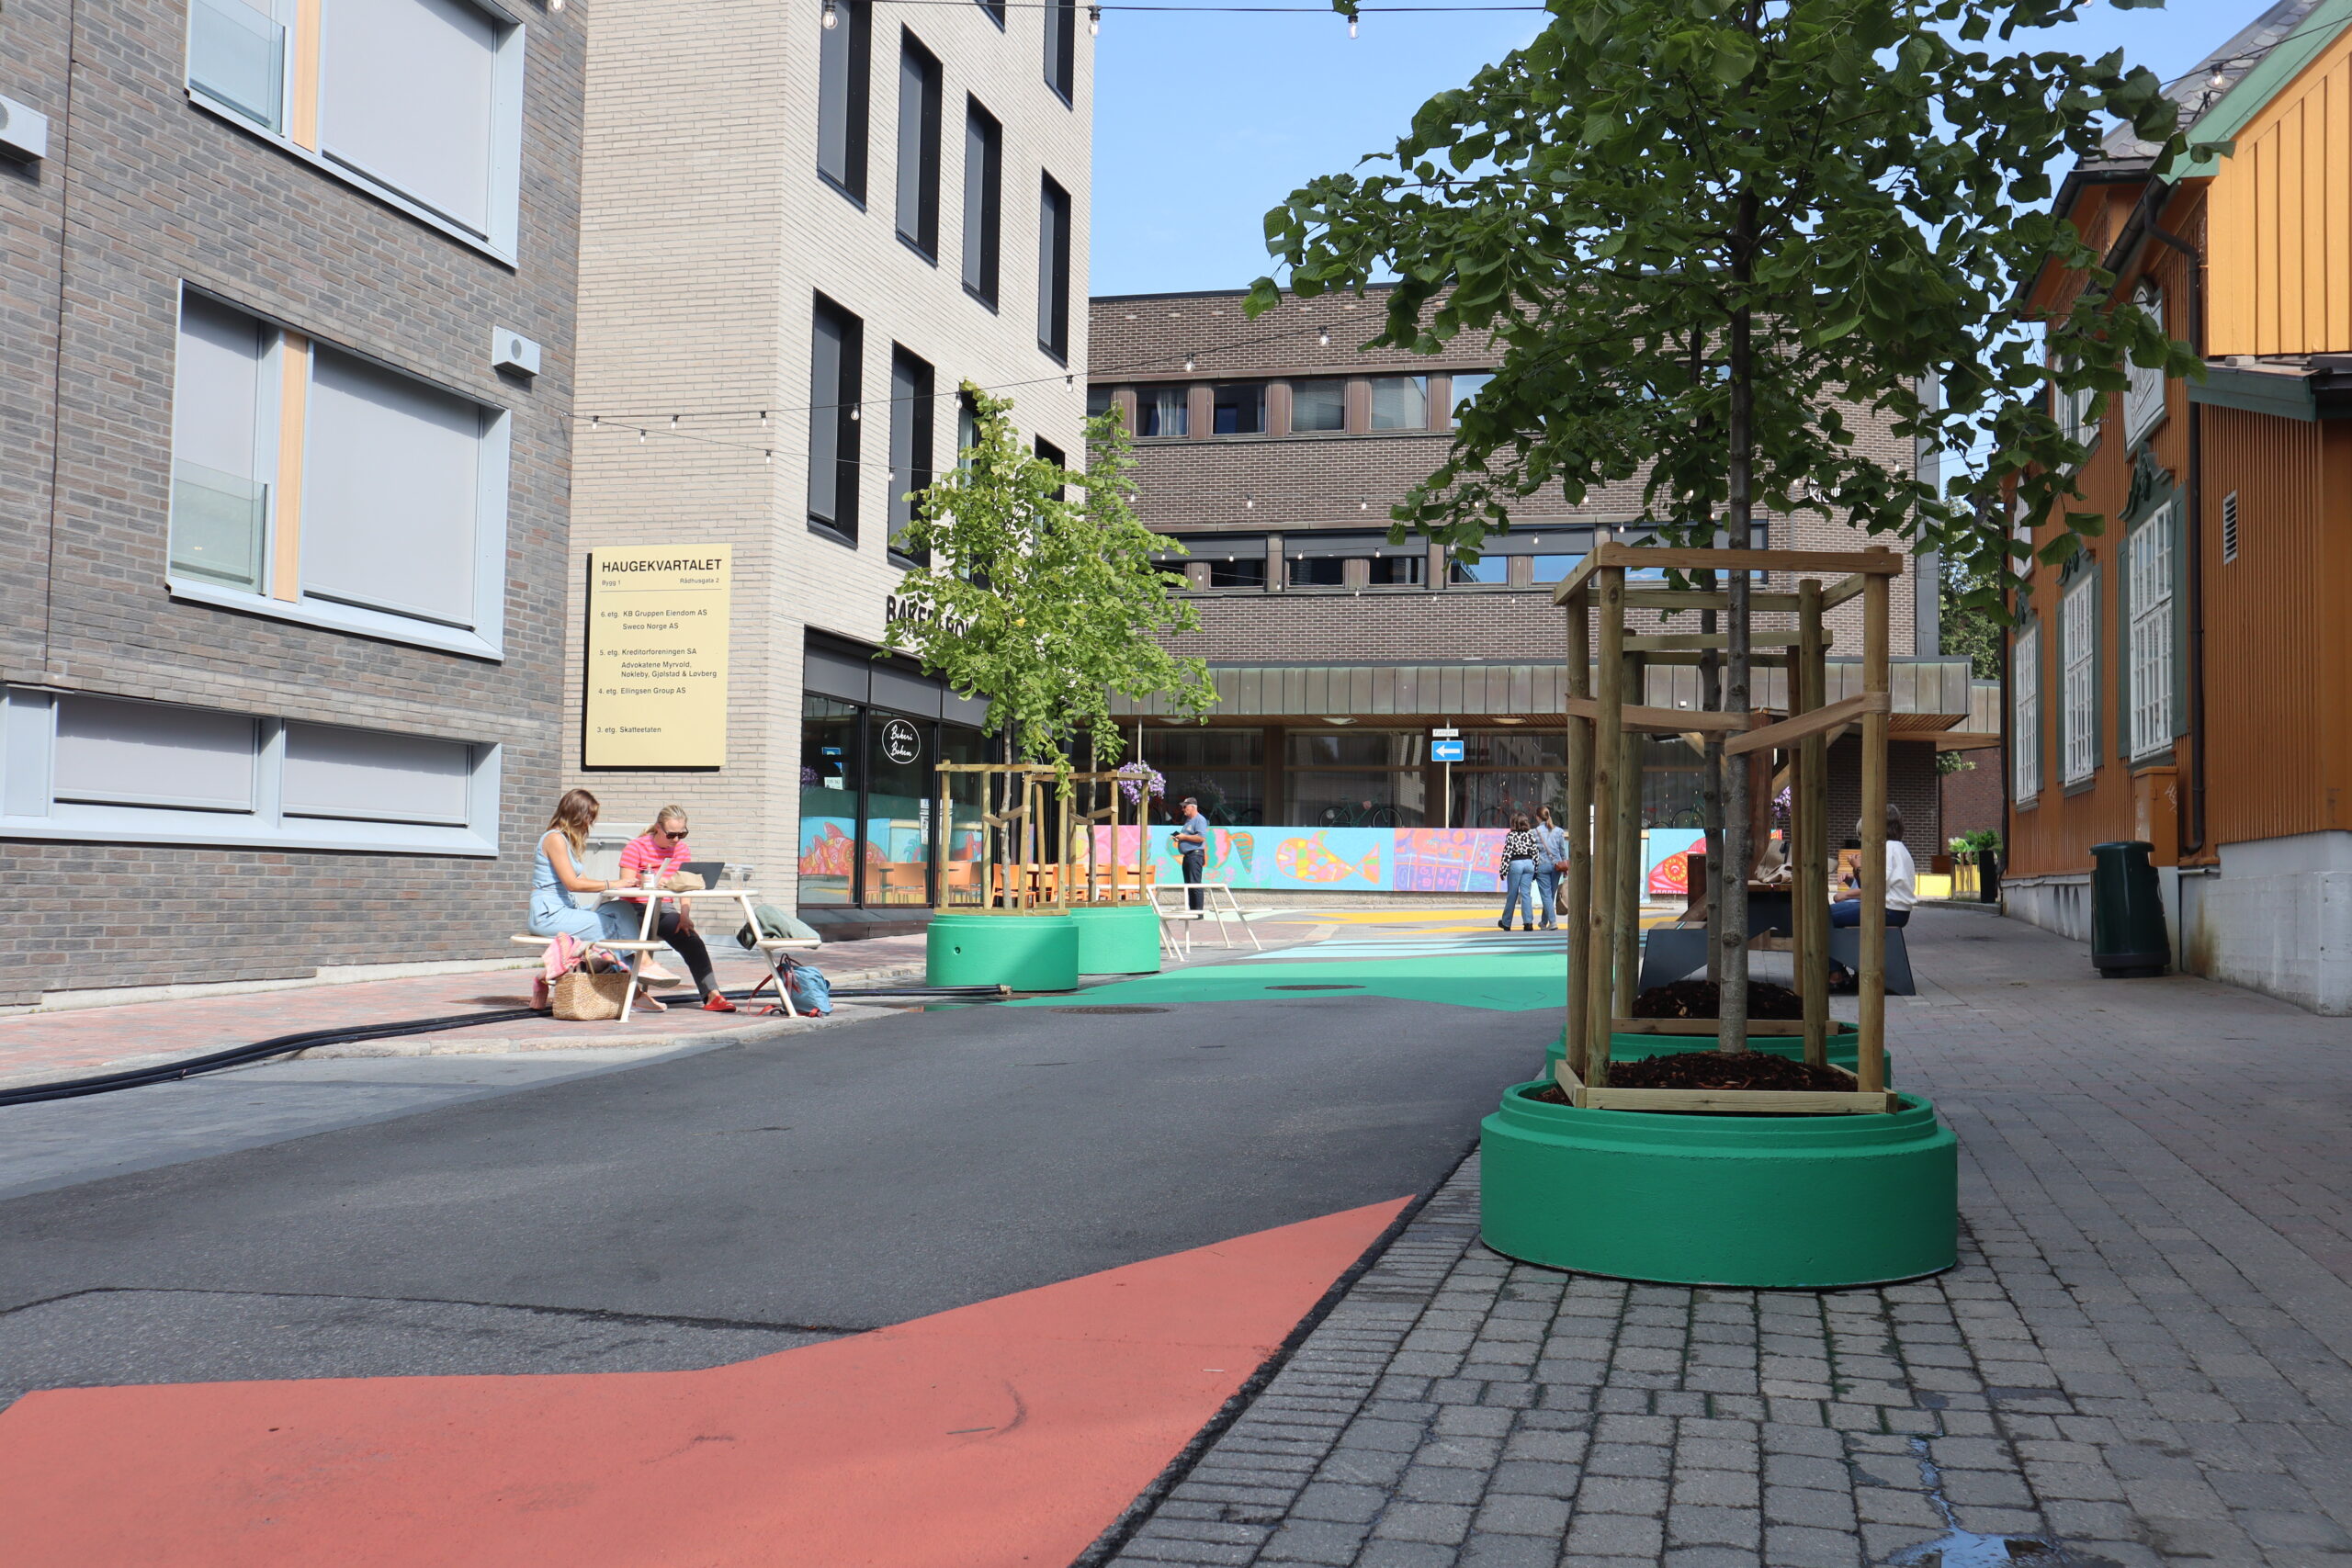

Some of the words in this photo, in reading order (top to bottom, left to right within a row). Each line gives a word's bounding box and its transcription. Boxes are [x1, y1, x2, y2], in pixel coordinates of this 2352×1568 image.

[602, 558, 722, 572] HAUGEKVARTALET
[635, 609, 664, 618] Gruppen
[646, 623, 667, 631] Norge
[621, 648, 685, 657] Kreditorforeningen
[620, 687, 651, 696] Ellingsen
[653, 687, 675, 695] Group
[890, 724, 913, 740] Bakeri
